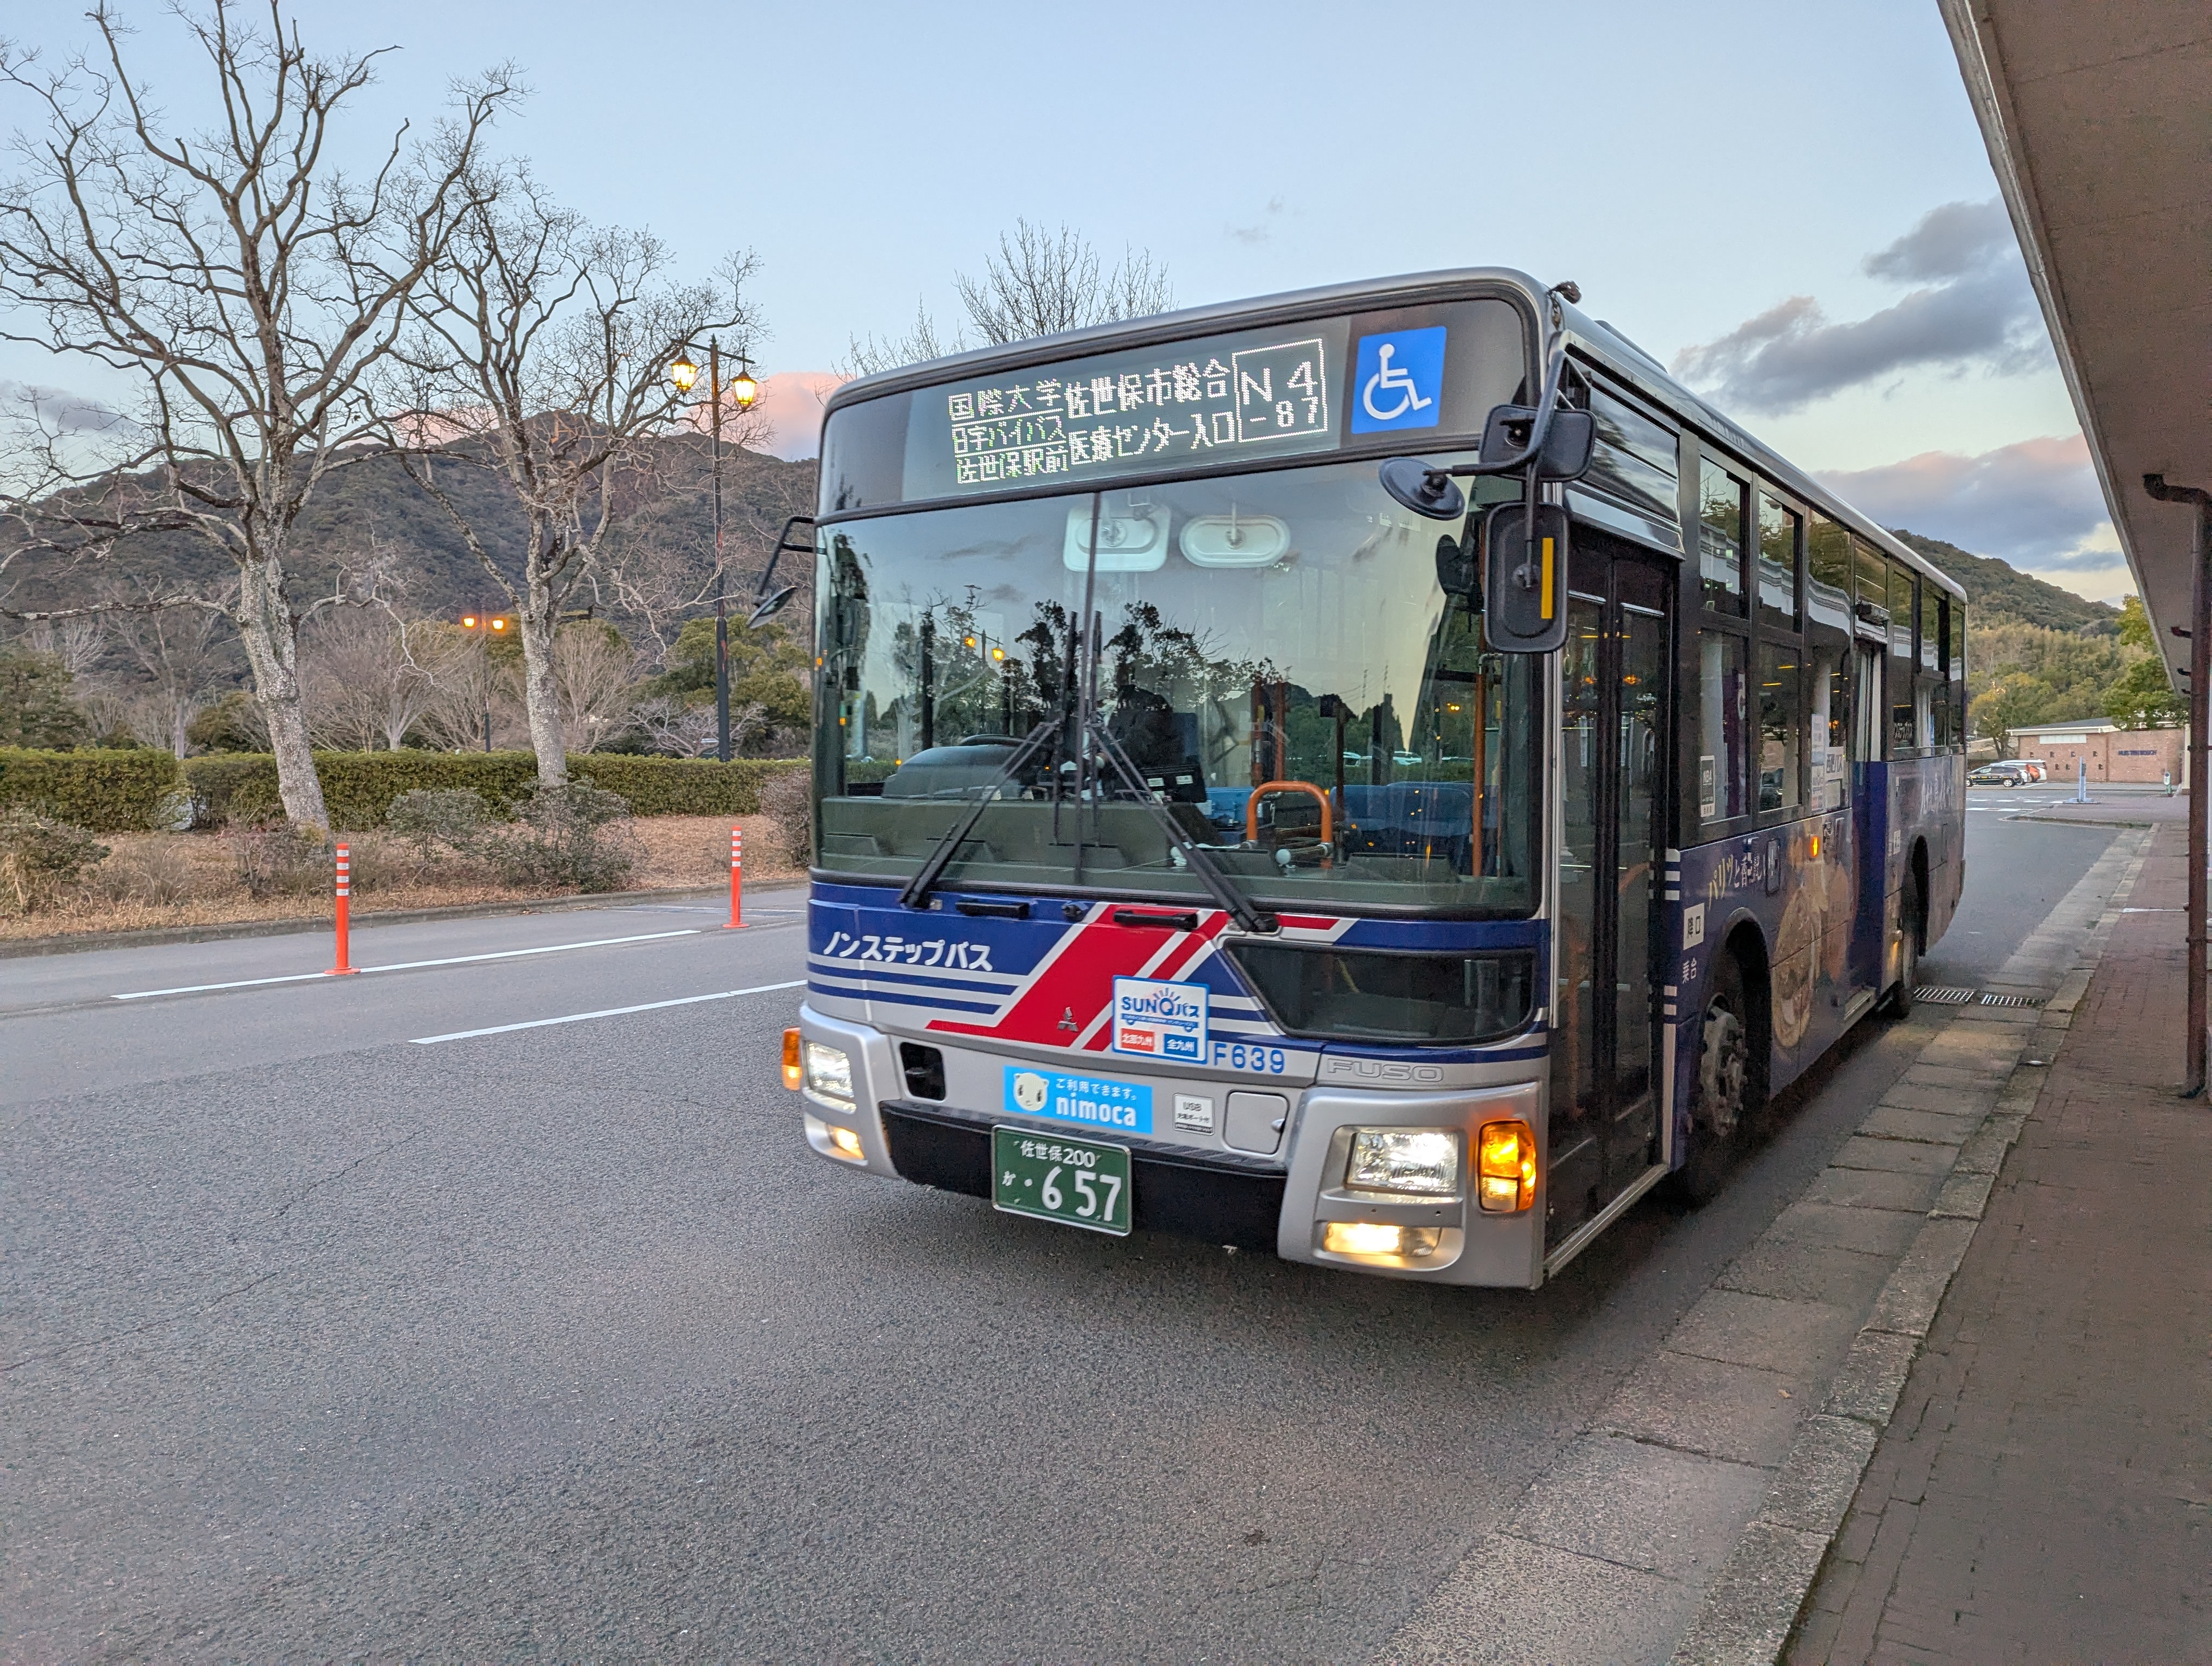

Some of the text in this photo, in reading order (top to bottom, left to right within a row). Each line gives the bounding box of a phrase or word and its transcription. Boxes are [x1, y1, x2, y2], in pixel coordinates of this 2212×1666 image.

[949, 379, 1061, 421] 国際大学
[1064, 359, 1230, 419] 佐世保市総合
[1068, 412, 1234, 465] 医療センター入口
[957, 445, 1069, 484] 佐世保駅前
[824, 931, 993, 972] ノンステップバス
[1166, 1039, 1195, 1052] 全九州
[1214, 1042, 1285, 1074] F639
[1326, 1057, 1444, 1083] FUSO
[1056, 1078, 1137, 1101] ご利用できます。
[1056, 1092, 1136, 1127] nimoca
